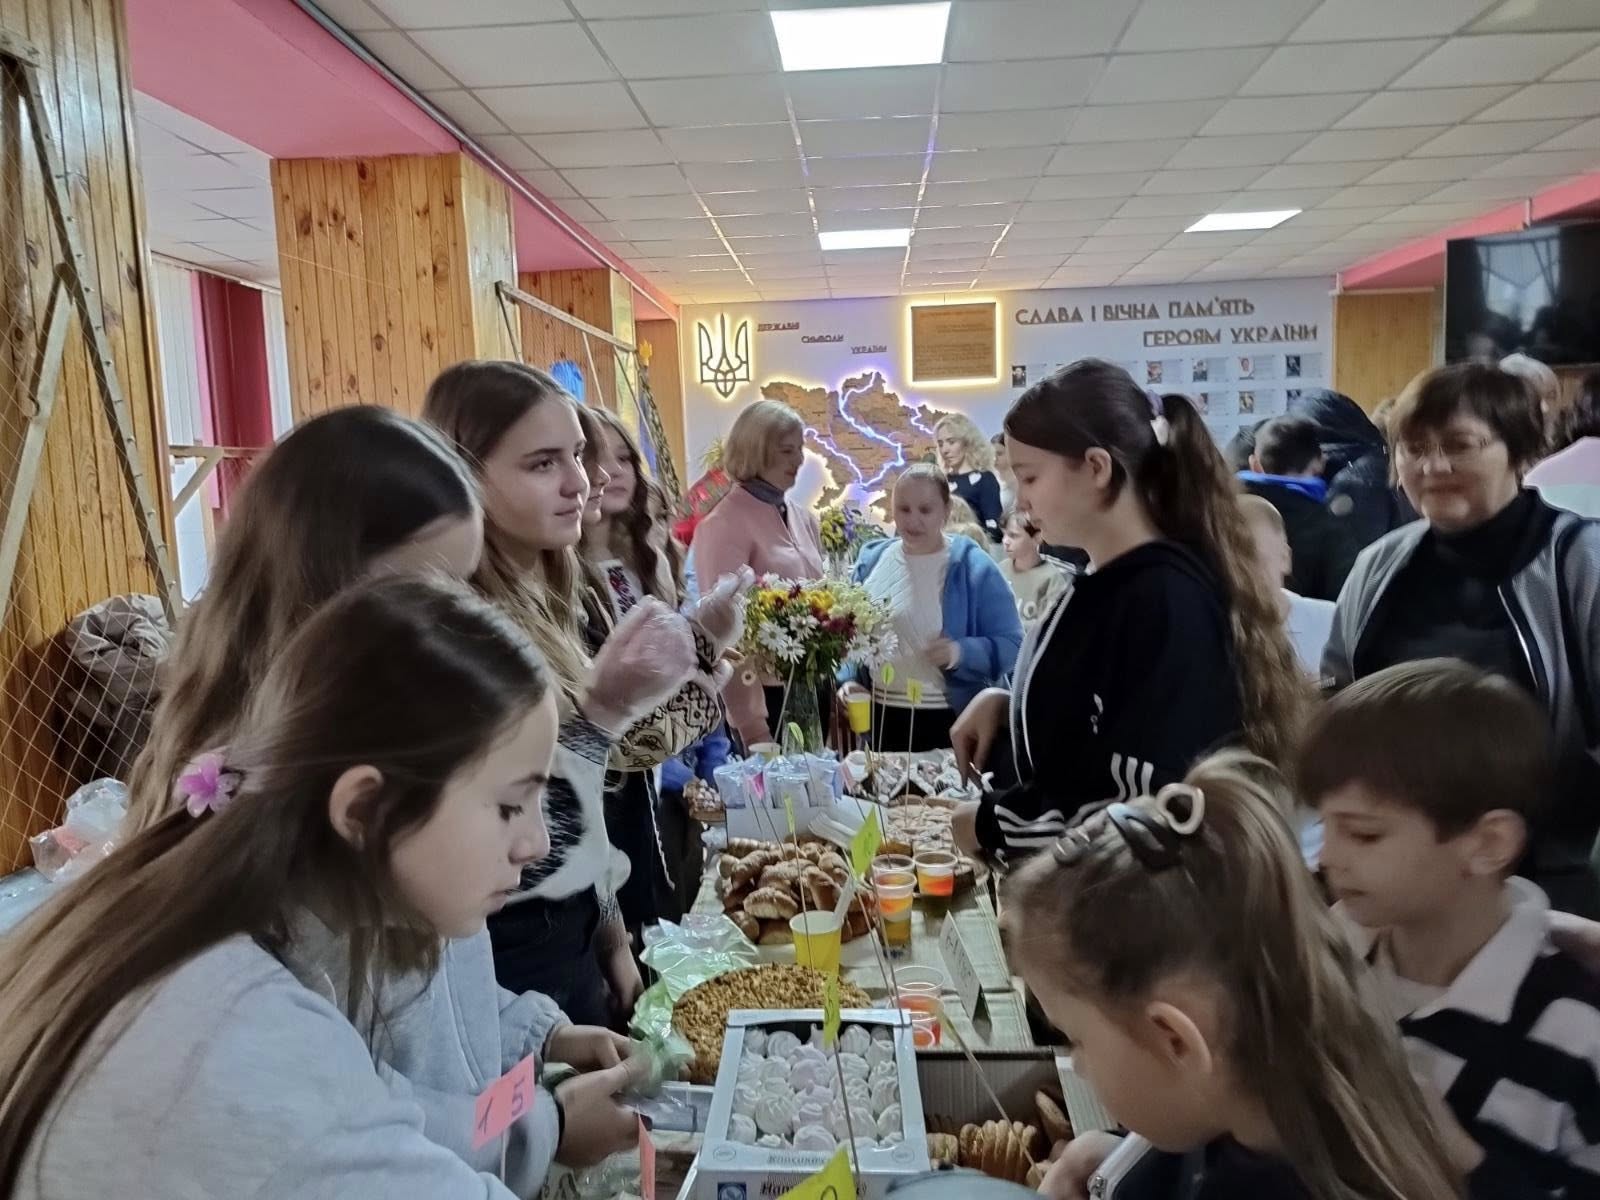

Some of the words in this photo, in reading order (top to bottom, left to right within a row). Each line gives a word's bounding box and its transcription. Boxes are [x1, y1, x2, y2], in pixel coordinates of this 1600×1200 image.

[1015, 306, 1083, 325] СЛАВА
[1091, 305, 1097, 321] І
[1103, 302, 1160, 321] ВІЧНА
[1144, 328, 1221, 347] ГЕРОЯМ
[1231, 323, 1317, 344] УКРАЇНИ
